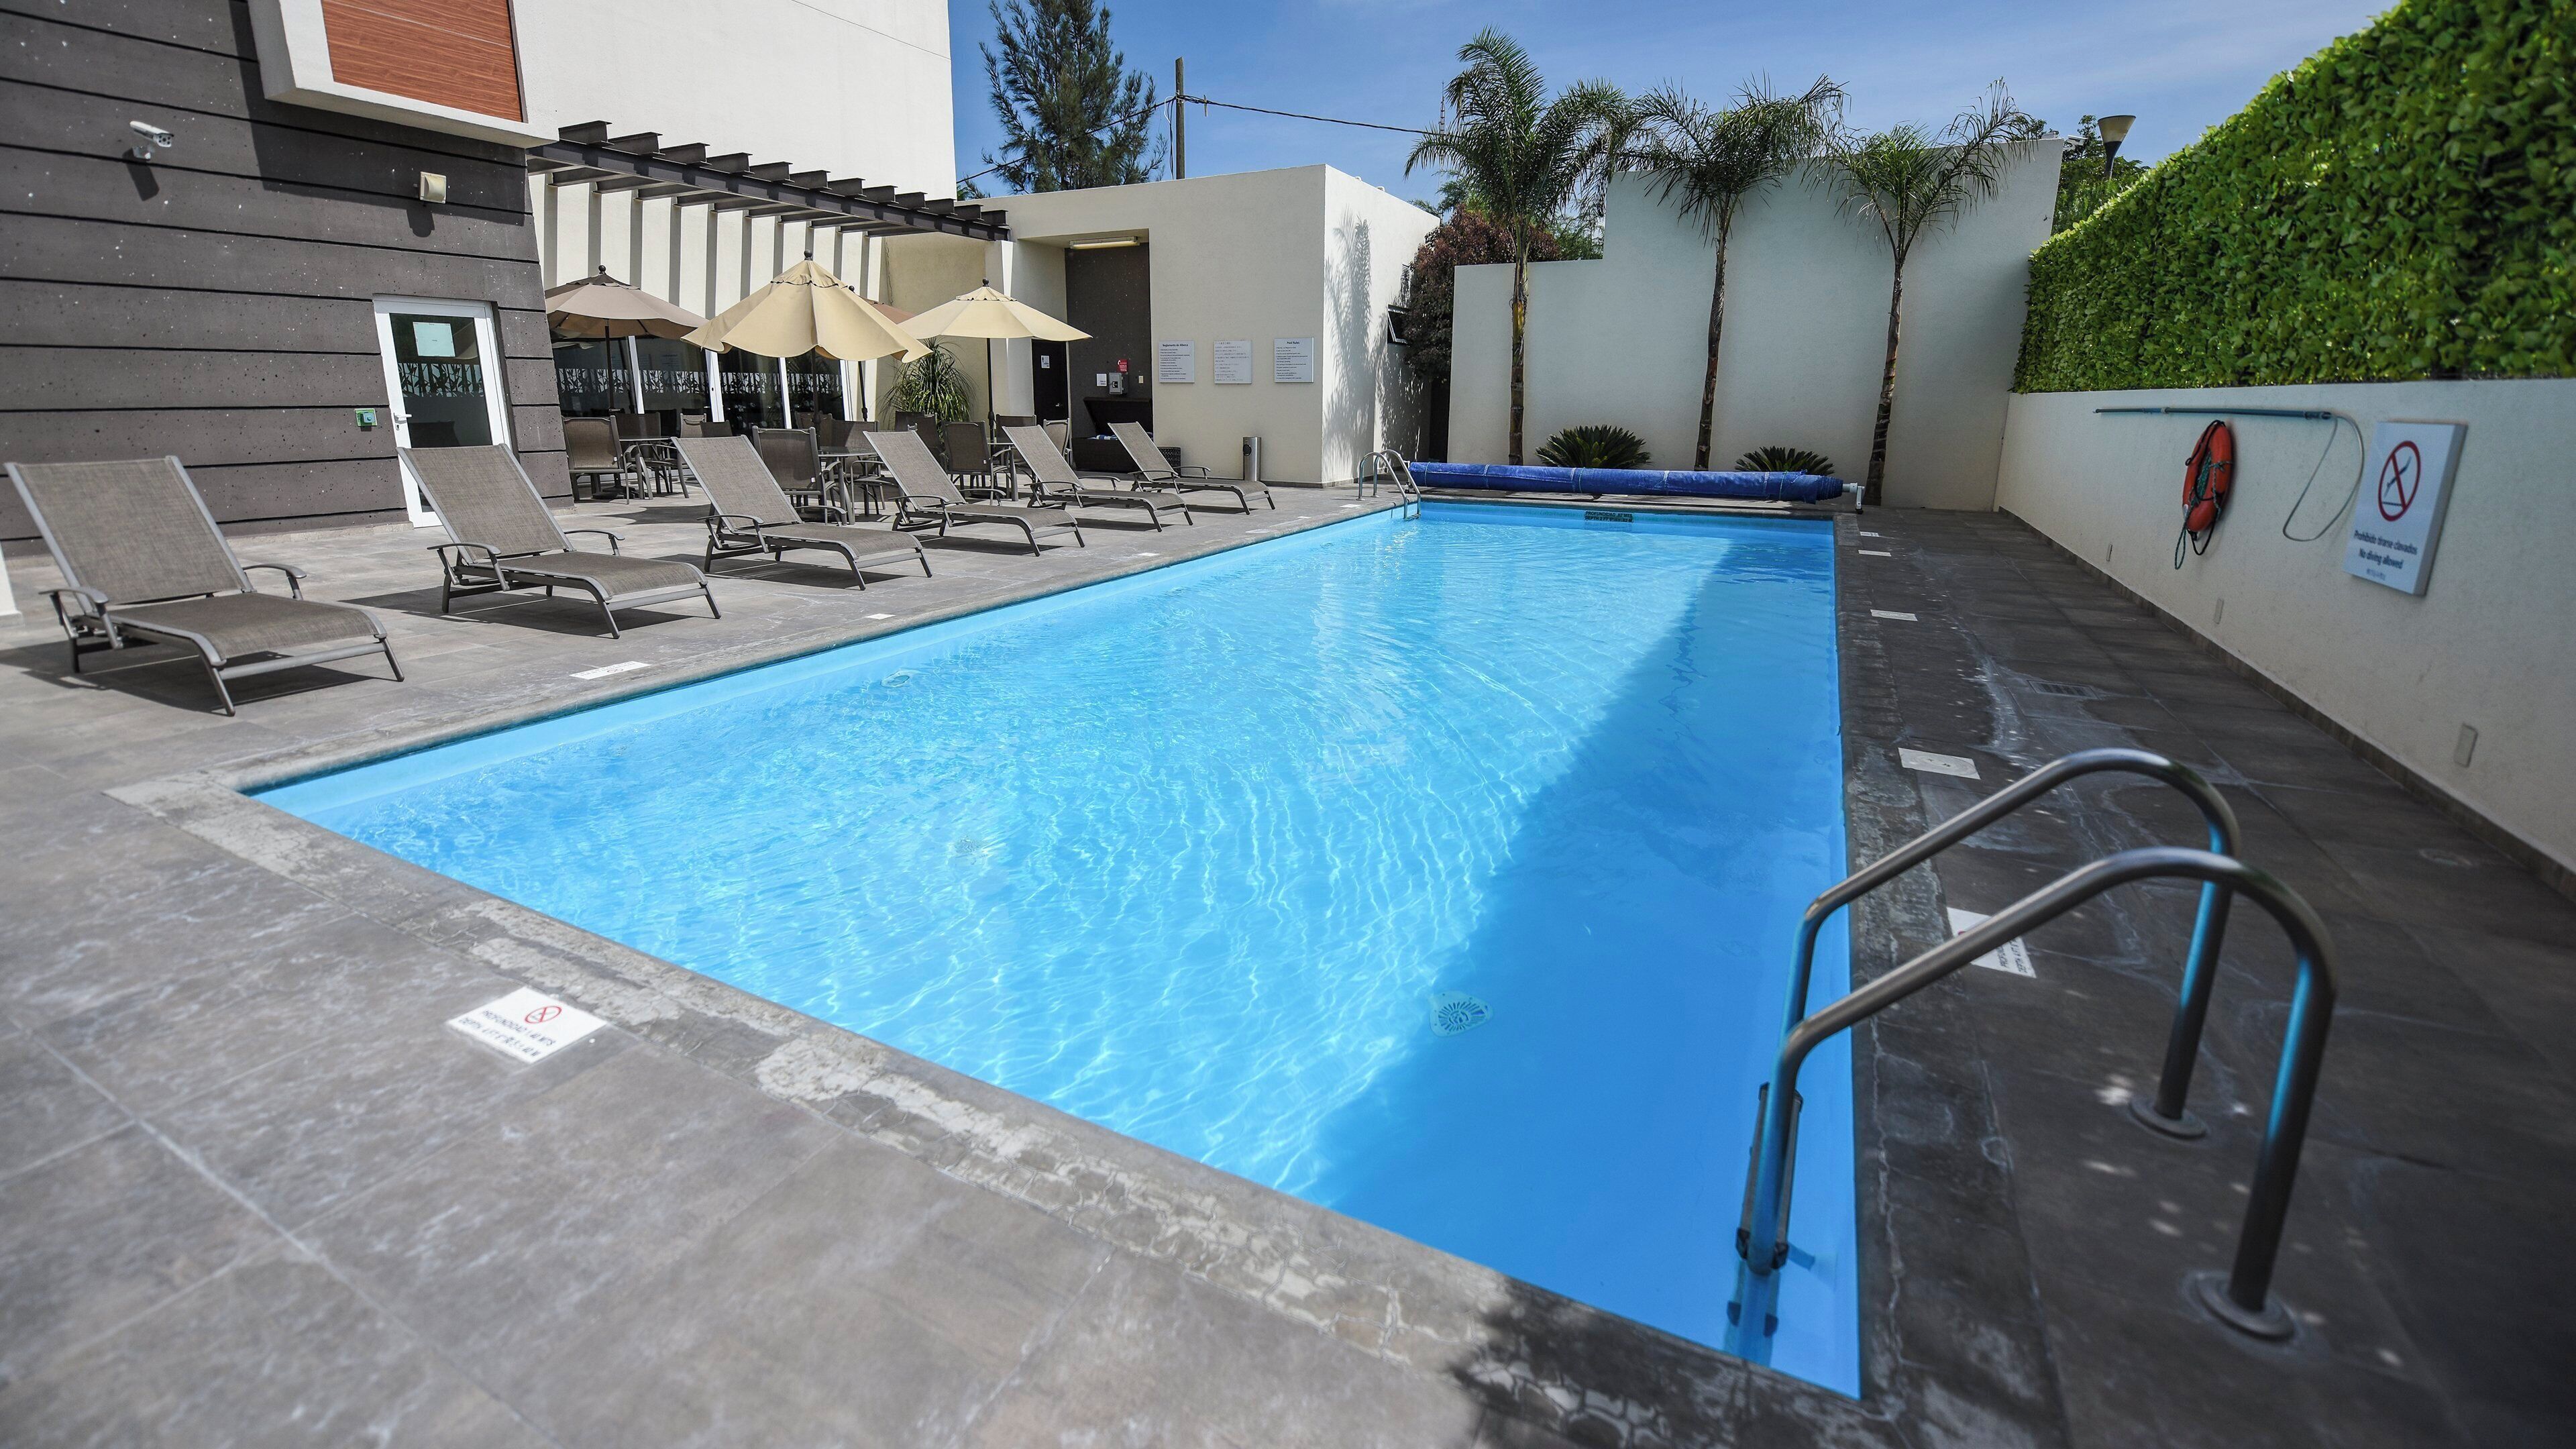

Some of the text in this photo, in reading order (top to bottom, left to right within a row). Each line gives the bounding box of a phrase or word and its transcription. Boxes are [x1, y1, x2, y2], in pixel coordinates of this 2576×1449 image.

[2354, 530, 2377, 544] Prohibido
[2393, 539, 2418, 555] clavados
[2359, 547, 2404, 570] No diving allowed
